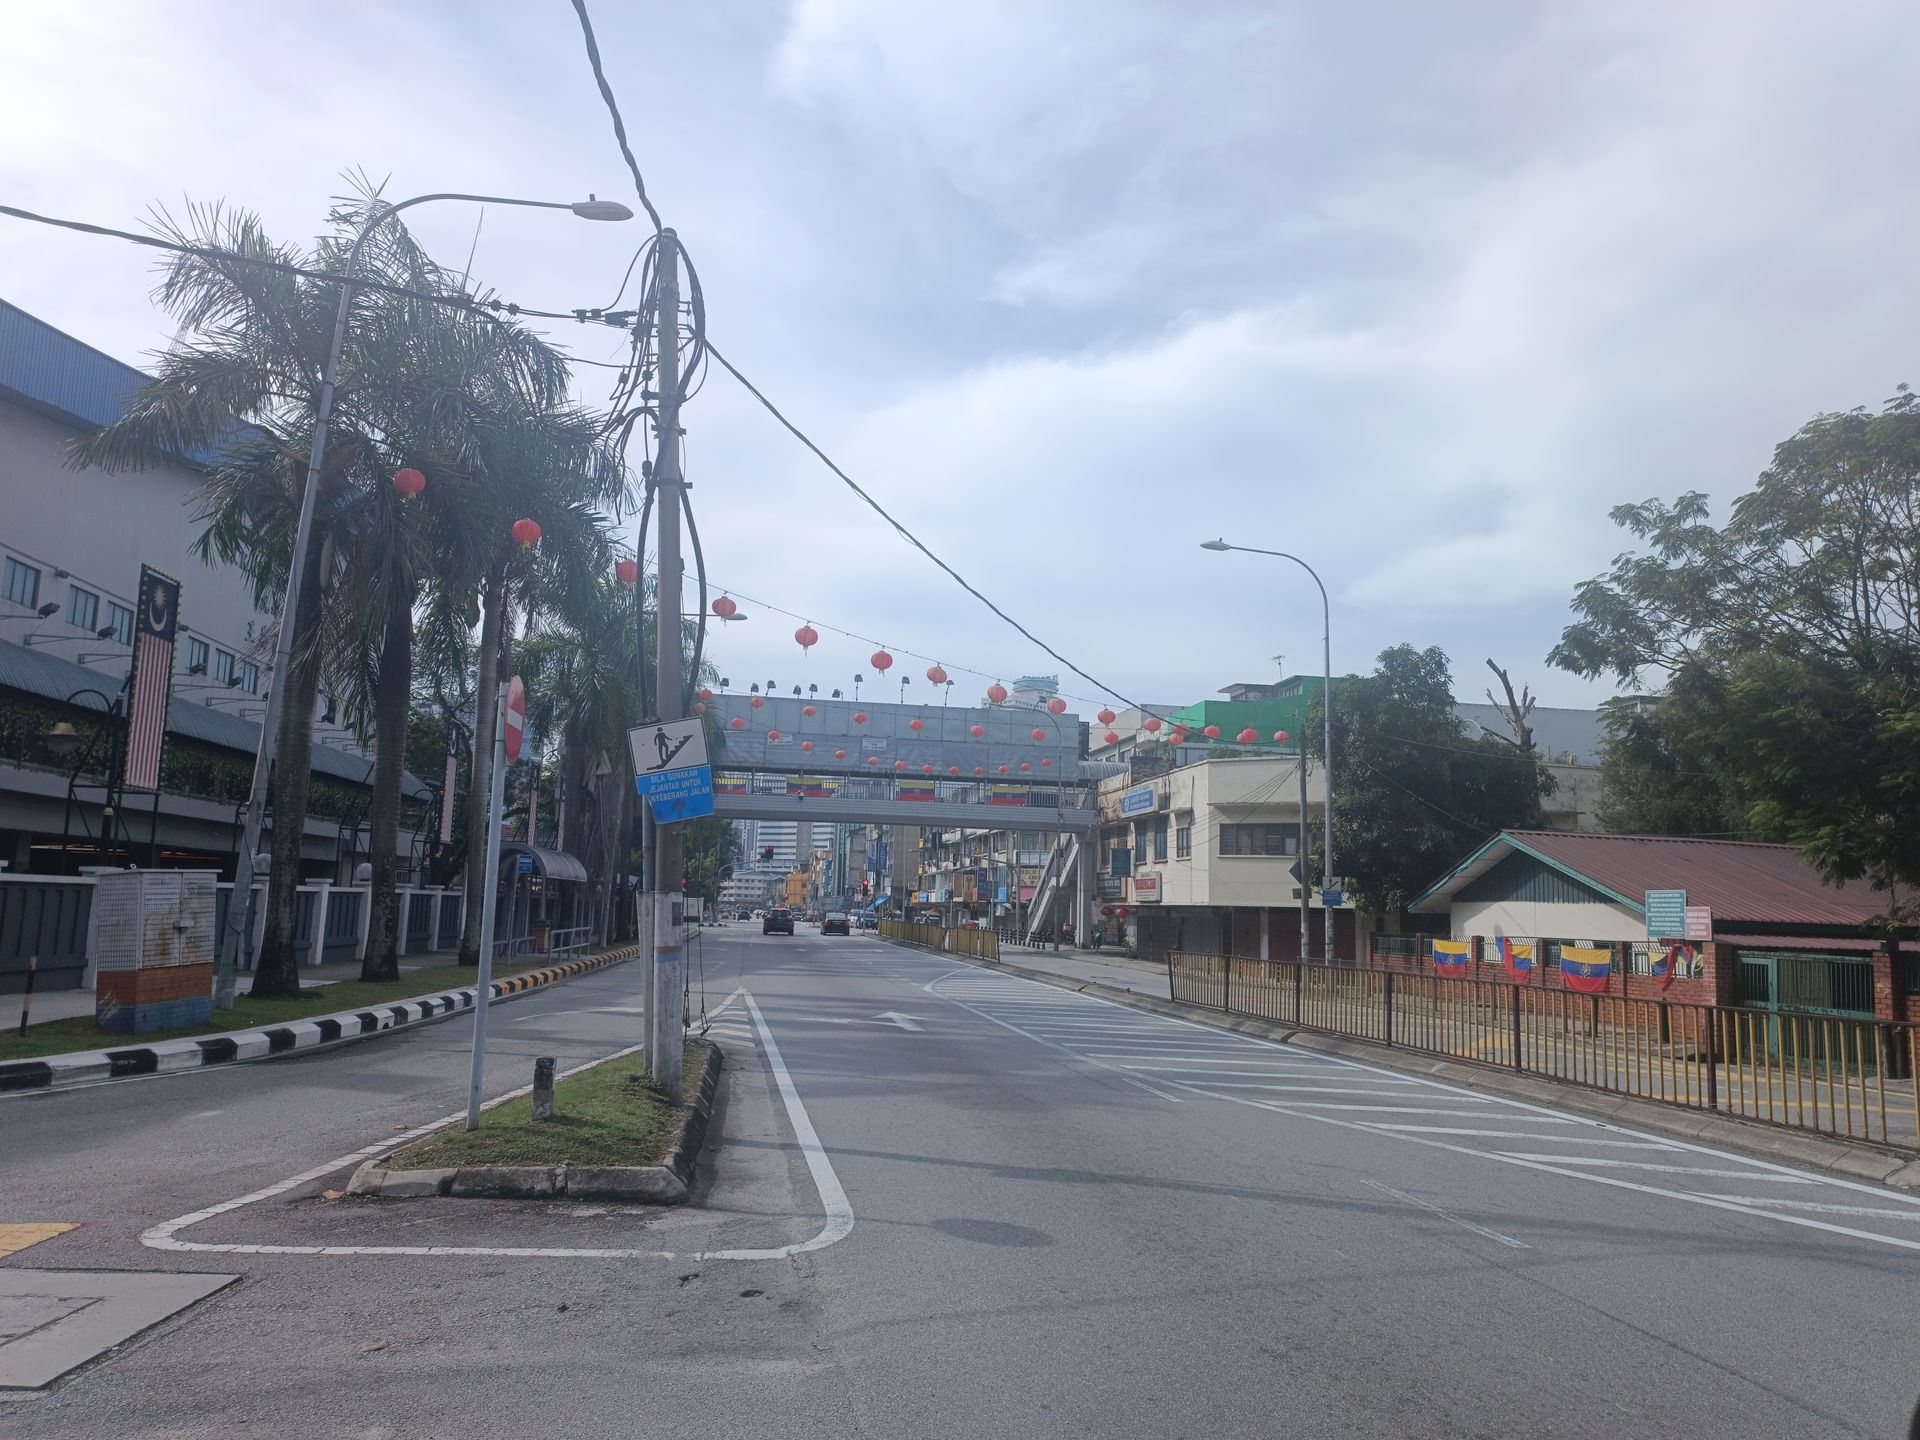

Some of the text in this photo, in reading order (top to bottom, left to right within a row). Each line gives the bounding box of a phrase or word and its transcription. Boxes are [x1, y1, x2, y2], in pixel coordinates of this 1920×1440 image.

[650, 769, 697, 783] SILA GUNAKAN
[650, 778, 701, 793] JEJANTAS UNTUK
[651, 786, 710, 802] NYEBERANG JALAN
